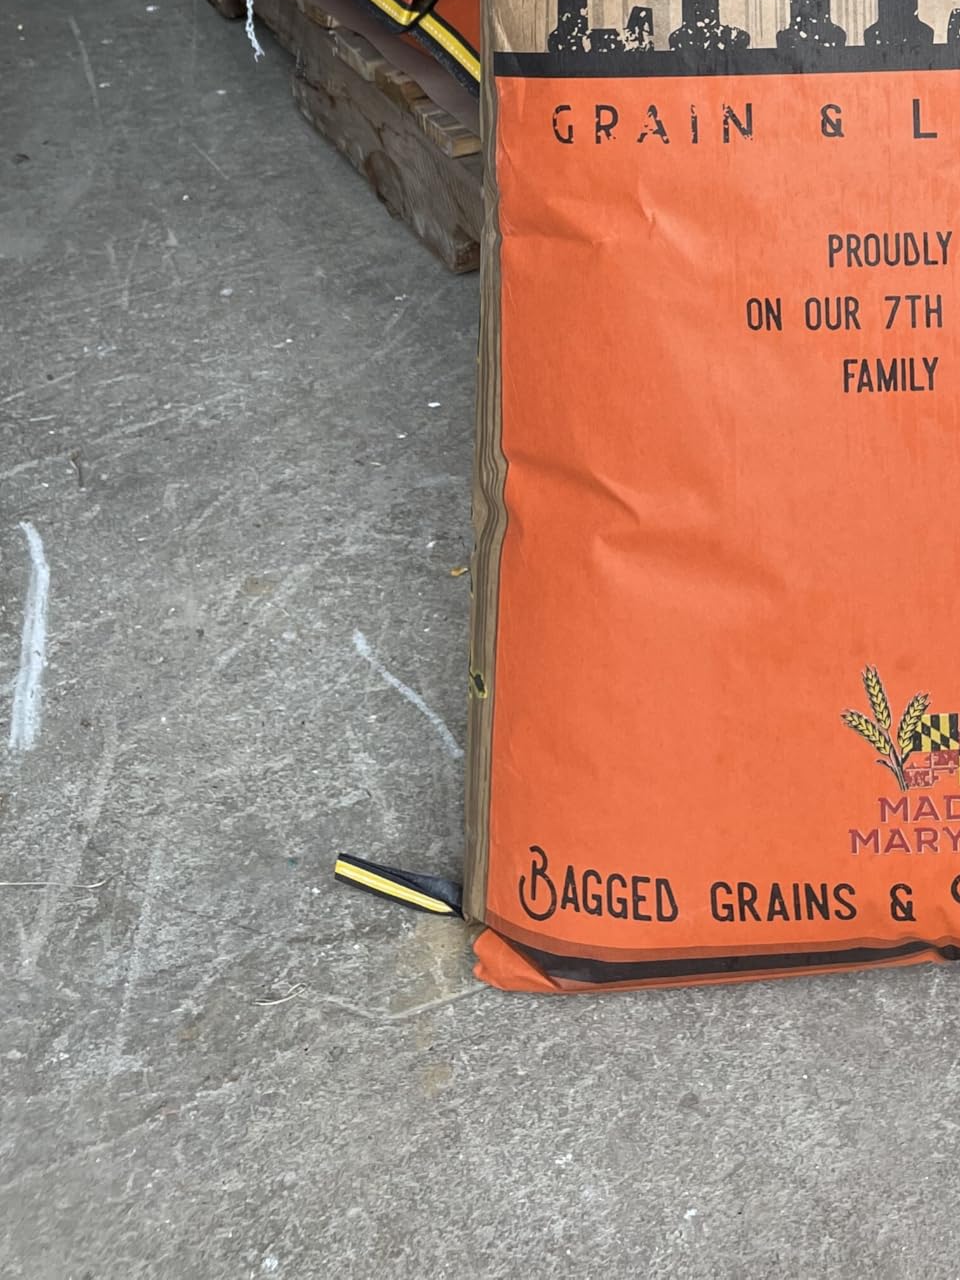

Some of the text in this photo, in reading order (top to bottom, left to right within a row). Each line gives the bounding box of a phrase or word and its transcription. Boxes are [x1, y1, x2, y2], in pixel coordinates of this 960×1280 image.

[552, 101, 755, 147] GRAIN
[820, 102, 846, 139] &
[827, 231, 953, 269] PROUDLY
[745, 298, 784, 332] ON
[803, 296, 862, 331] OUR
[883, 293, 944, 330] 7TH
[842, 357, 939, 394] FAMILY
[518, 845, 679, 922] BAGGED
[710, 881, 858, 922] GRAINS
[889, 883, 917, 922] &
